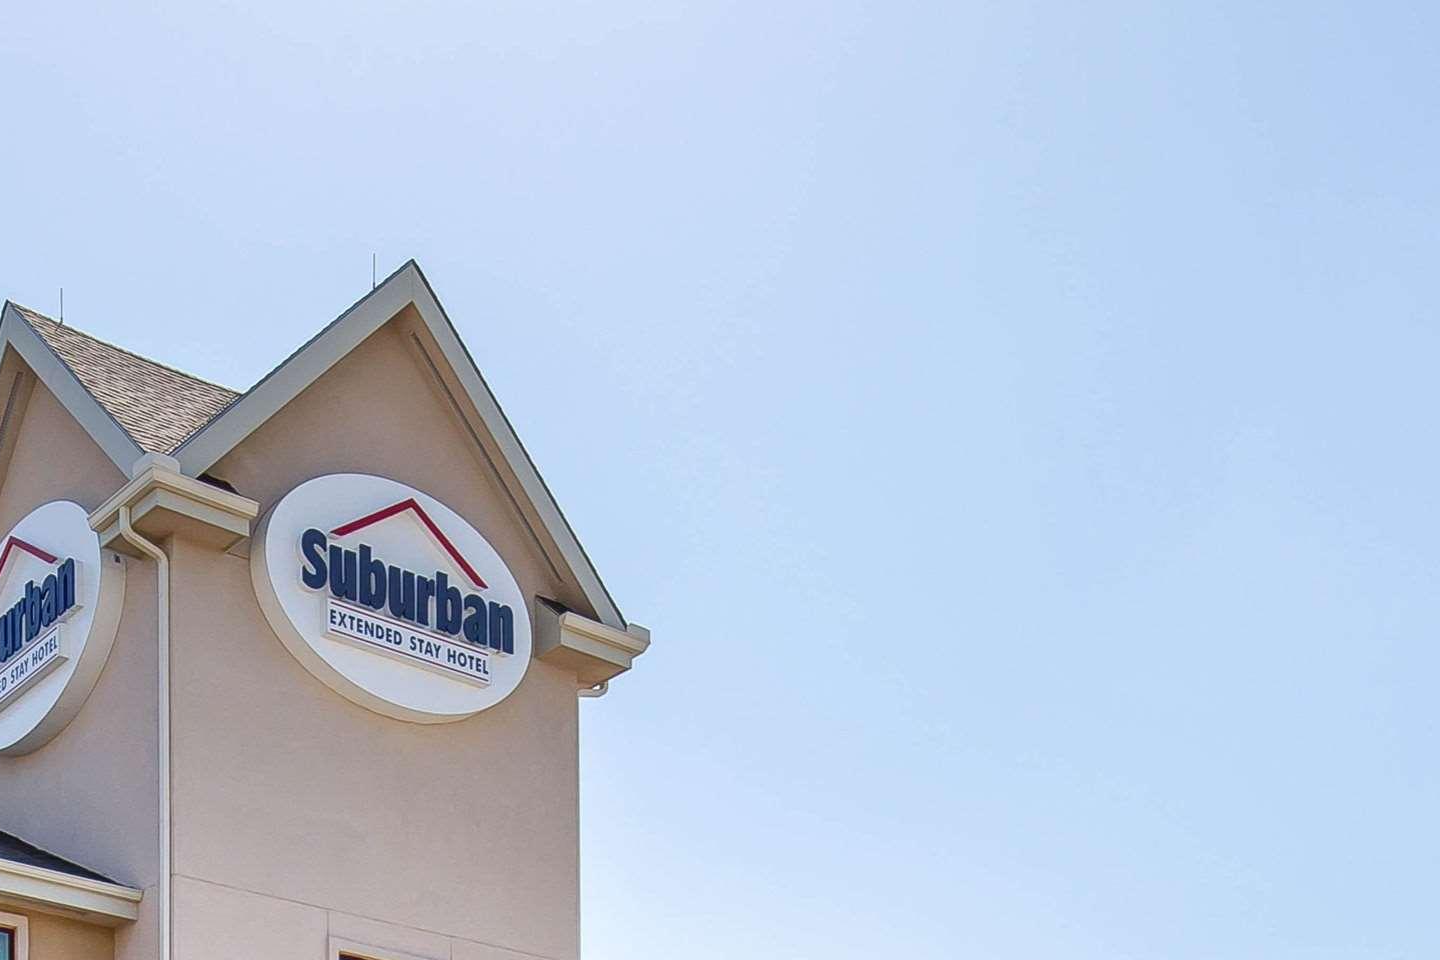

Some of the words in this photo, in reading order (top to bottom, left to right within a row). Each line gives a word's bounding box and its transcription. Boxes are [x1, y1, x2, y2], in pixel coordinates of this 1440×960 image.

[301, 528, 515, 655] Suburban
[10, 663, 30, 684] STAY
[32, 635, 58, 666] HOTEL
[329, 609, 403, 646] EXTENDED
[409, 636, 441, 659] STAY
[446, 650, 489, 675] HOTEL
